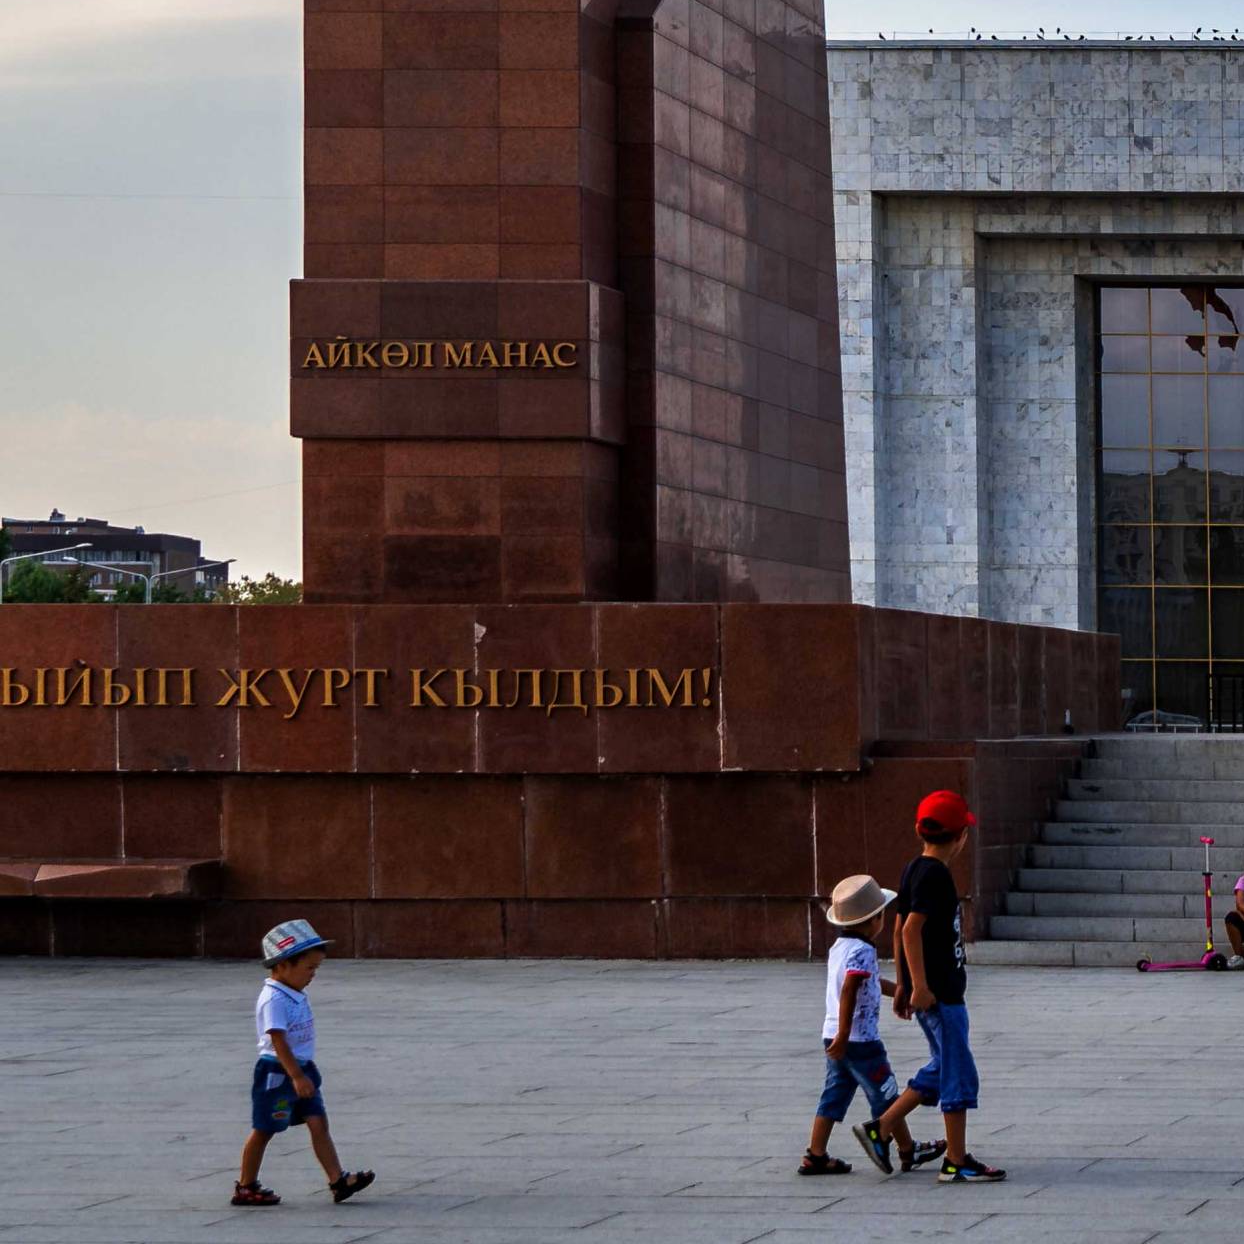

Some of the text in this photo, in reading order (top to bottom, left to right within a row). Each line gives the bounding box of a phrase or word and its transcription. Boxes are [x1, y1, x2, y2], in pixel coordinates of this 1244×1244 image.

[302, 336, 577, 368] АЙКӨЛ МАНАС
[216, 667, 388, 719] ЖУРТ
[409, 667, 712, 717] КЫЛДЫМ!
